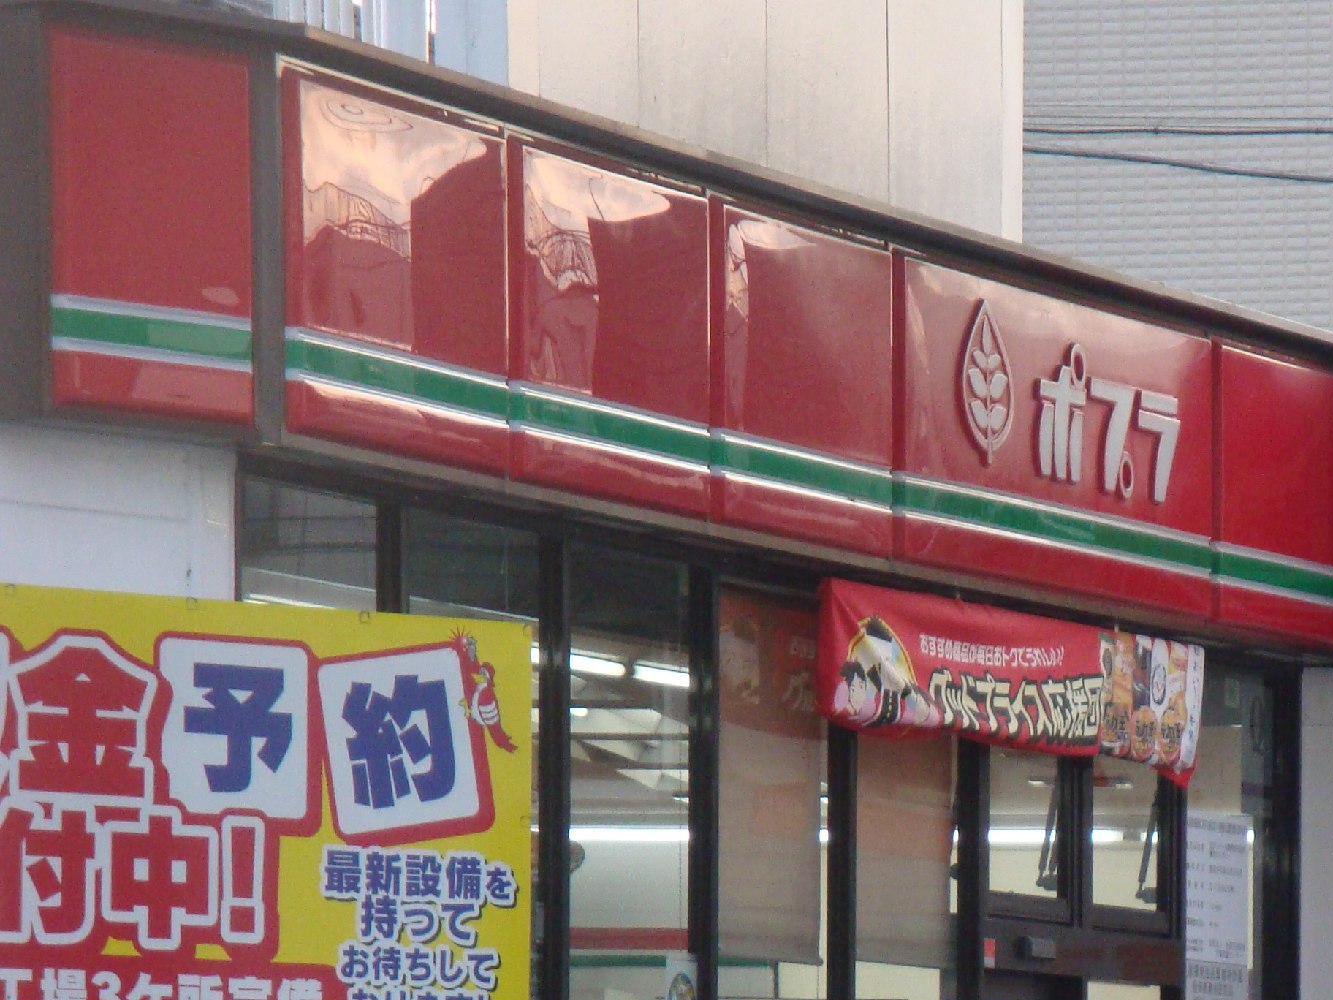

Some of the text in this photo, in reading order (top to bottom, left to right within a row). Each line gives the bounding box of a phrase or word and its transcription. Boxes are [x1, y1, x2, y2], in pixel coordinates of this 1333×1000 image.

[1036, 342, 1182, 504] ポプラ
[928, 667, 1104, 742] グッドプライス応援団
[324, 850, 516, 901] 最新設備を
[361, 901, 478, 942] 持って
[341, 948, 497, 986] お待ちして
